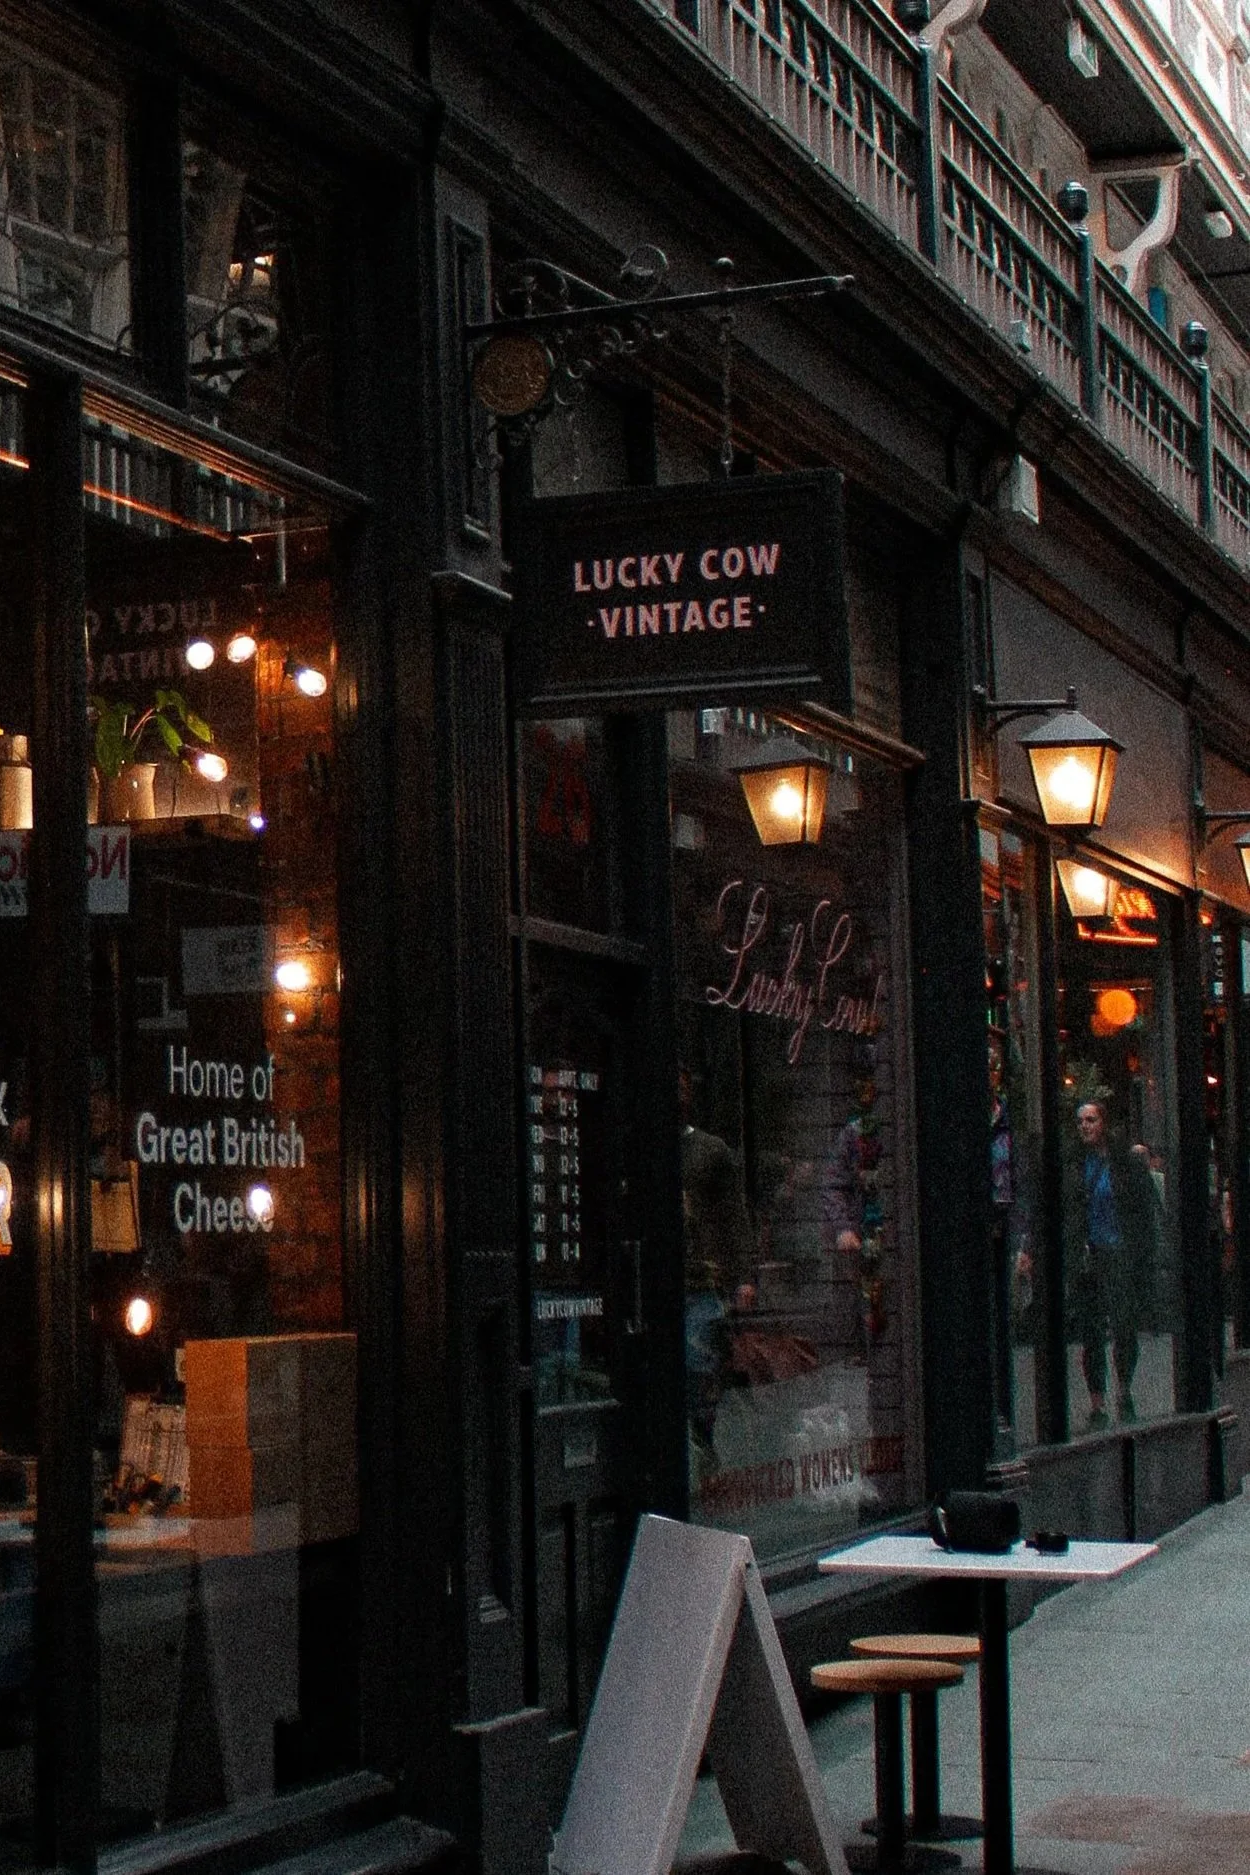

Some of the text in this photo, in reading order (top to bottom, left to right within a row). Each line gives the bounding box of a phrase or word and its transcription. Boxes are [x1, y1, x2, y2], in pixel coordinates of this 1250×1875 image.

[574, 543, 781, 593] LUCKY COW
[169, 1045, 275, 1101] Home of
[137, 1112, 306, 1169] Great British
